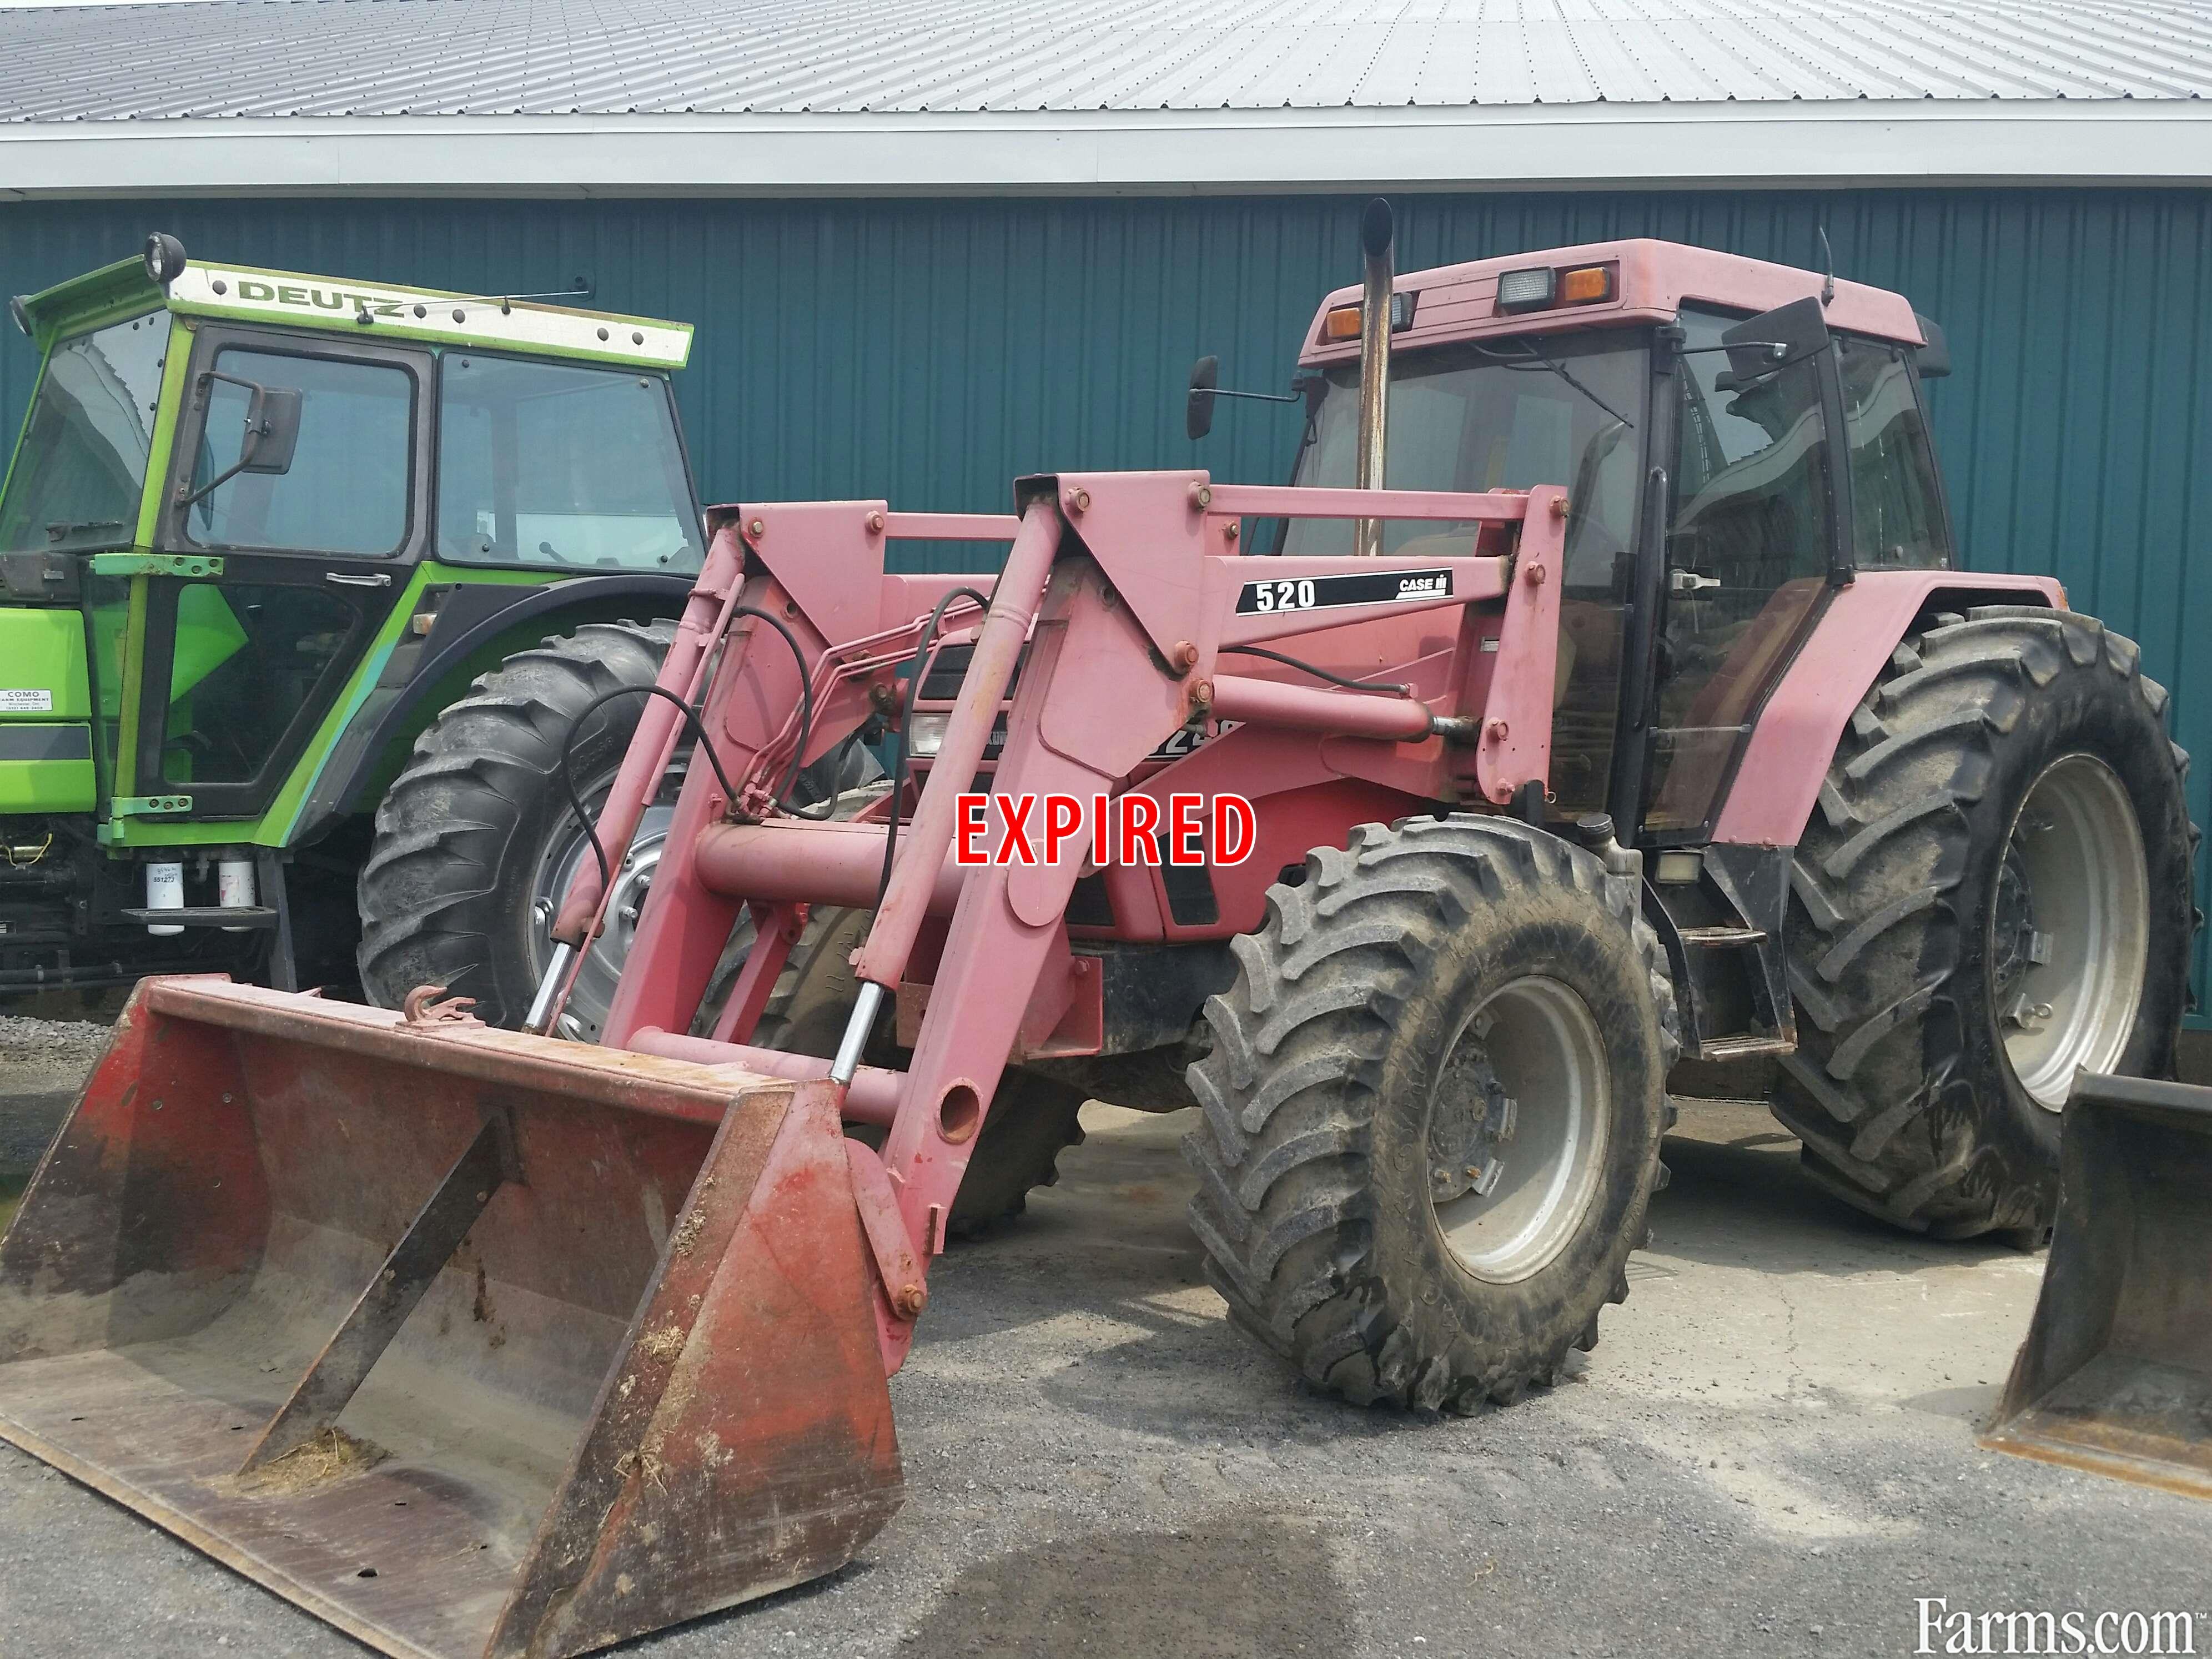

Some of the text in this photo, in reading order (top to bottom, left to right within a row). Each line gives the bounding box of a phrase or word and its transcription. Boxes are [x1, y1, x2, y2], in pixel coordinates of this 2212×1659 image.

[238, 281, 404, 318] DEUTZ
[1256, 580, 1315, 611] 520
[1399, 579, 1434, 591] CASE
